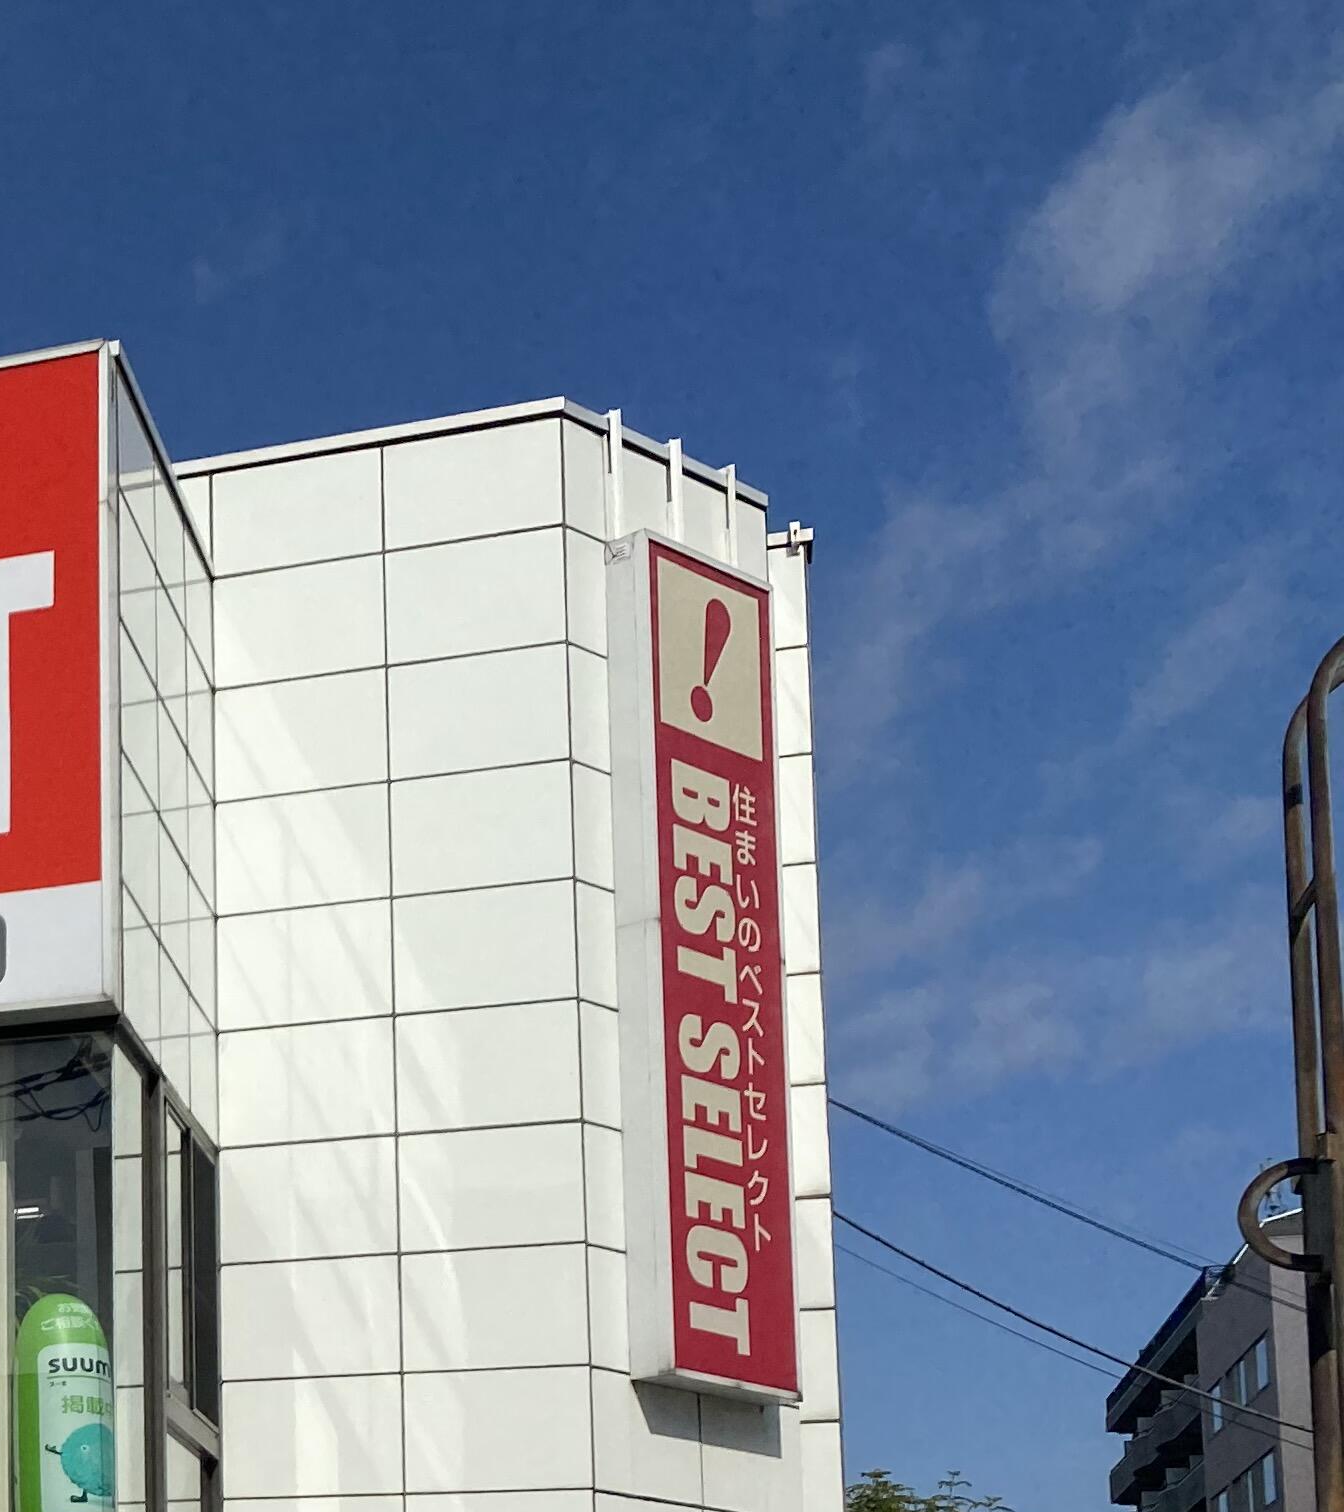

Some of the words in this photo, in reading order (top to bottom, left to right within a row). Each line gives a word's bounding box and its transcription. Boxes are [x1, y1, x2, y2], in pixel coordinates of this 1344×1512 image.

[669, 759, 739, 1006] BEST
[732, 784, 772, 1252] 住まいのベストセレクト
[678, 1012, 751, 1358] SELECT
